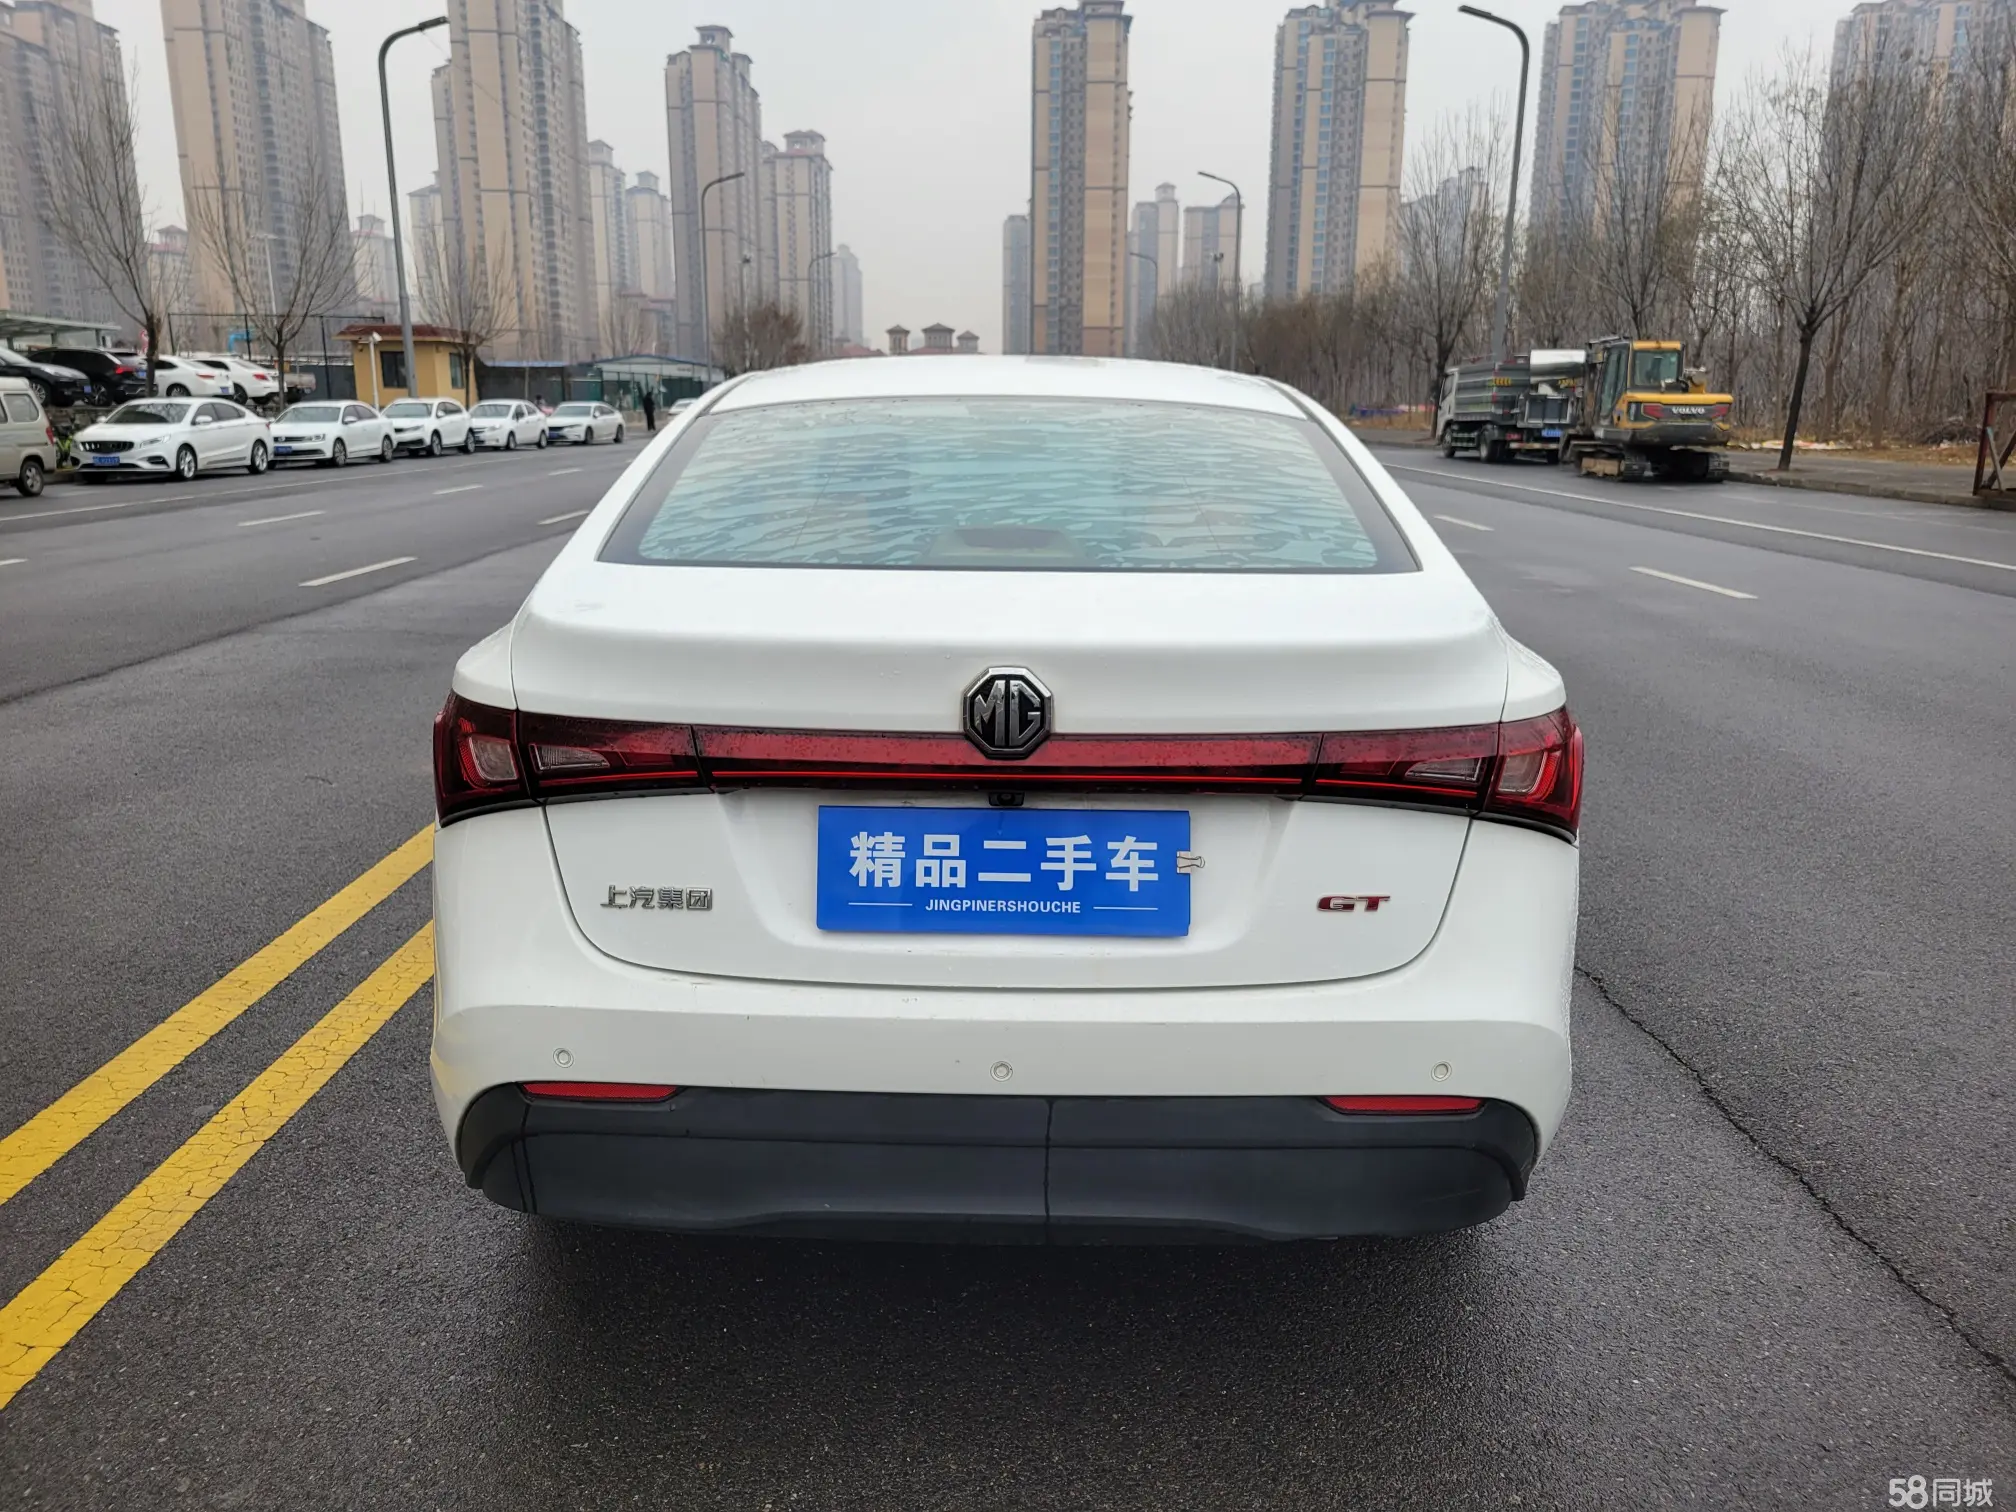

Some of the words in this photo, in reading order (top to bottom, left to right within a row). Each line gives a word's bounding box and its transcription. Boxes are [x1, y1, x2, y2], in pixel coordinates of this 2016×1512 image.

[973, 680, 1041, 747] MG
[849, 831, 1159, 891] 精品二手车
[600, 885, 713, 910] 上汽集团
[925, 898, 1081, 914] JINGPINERSHOUCHE
[1317, 896, 1391, 912] GT
